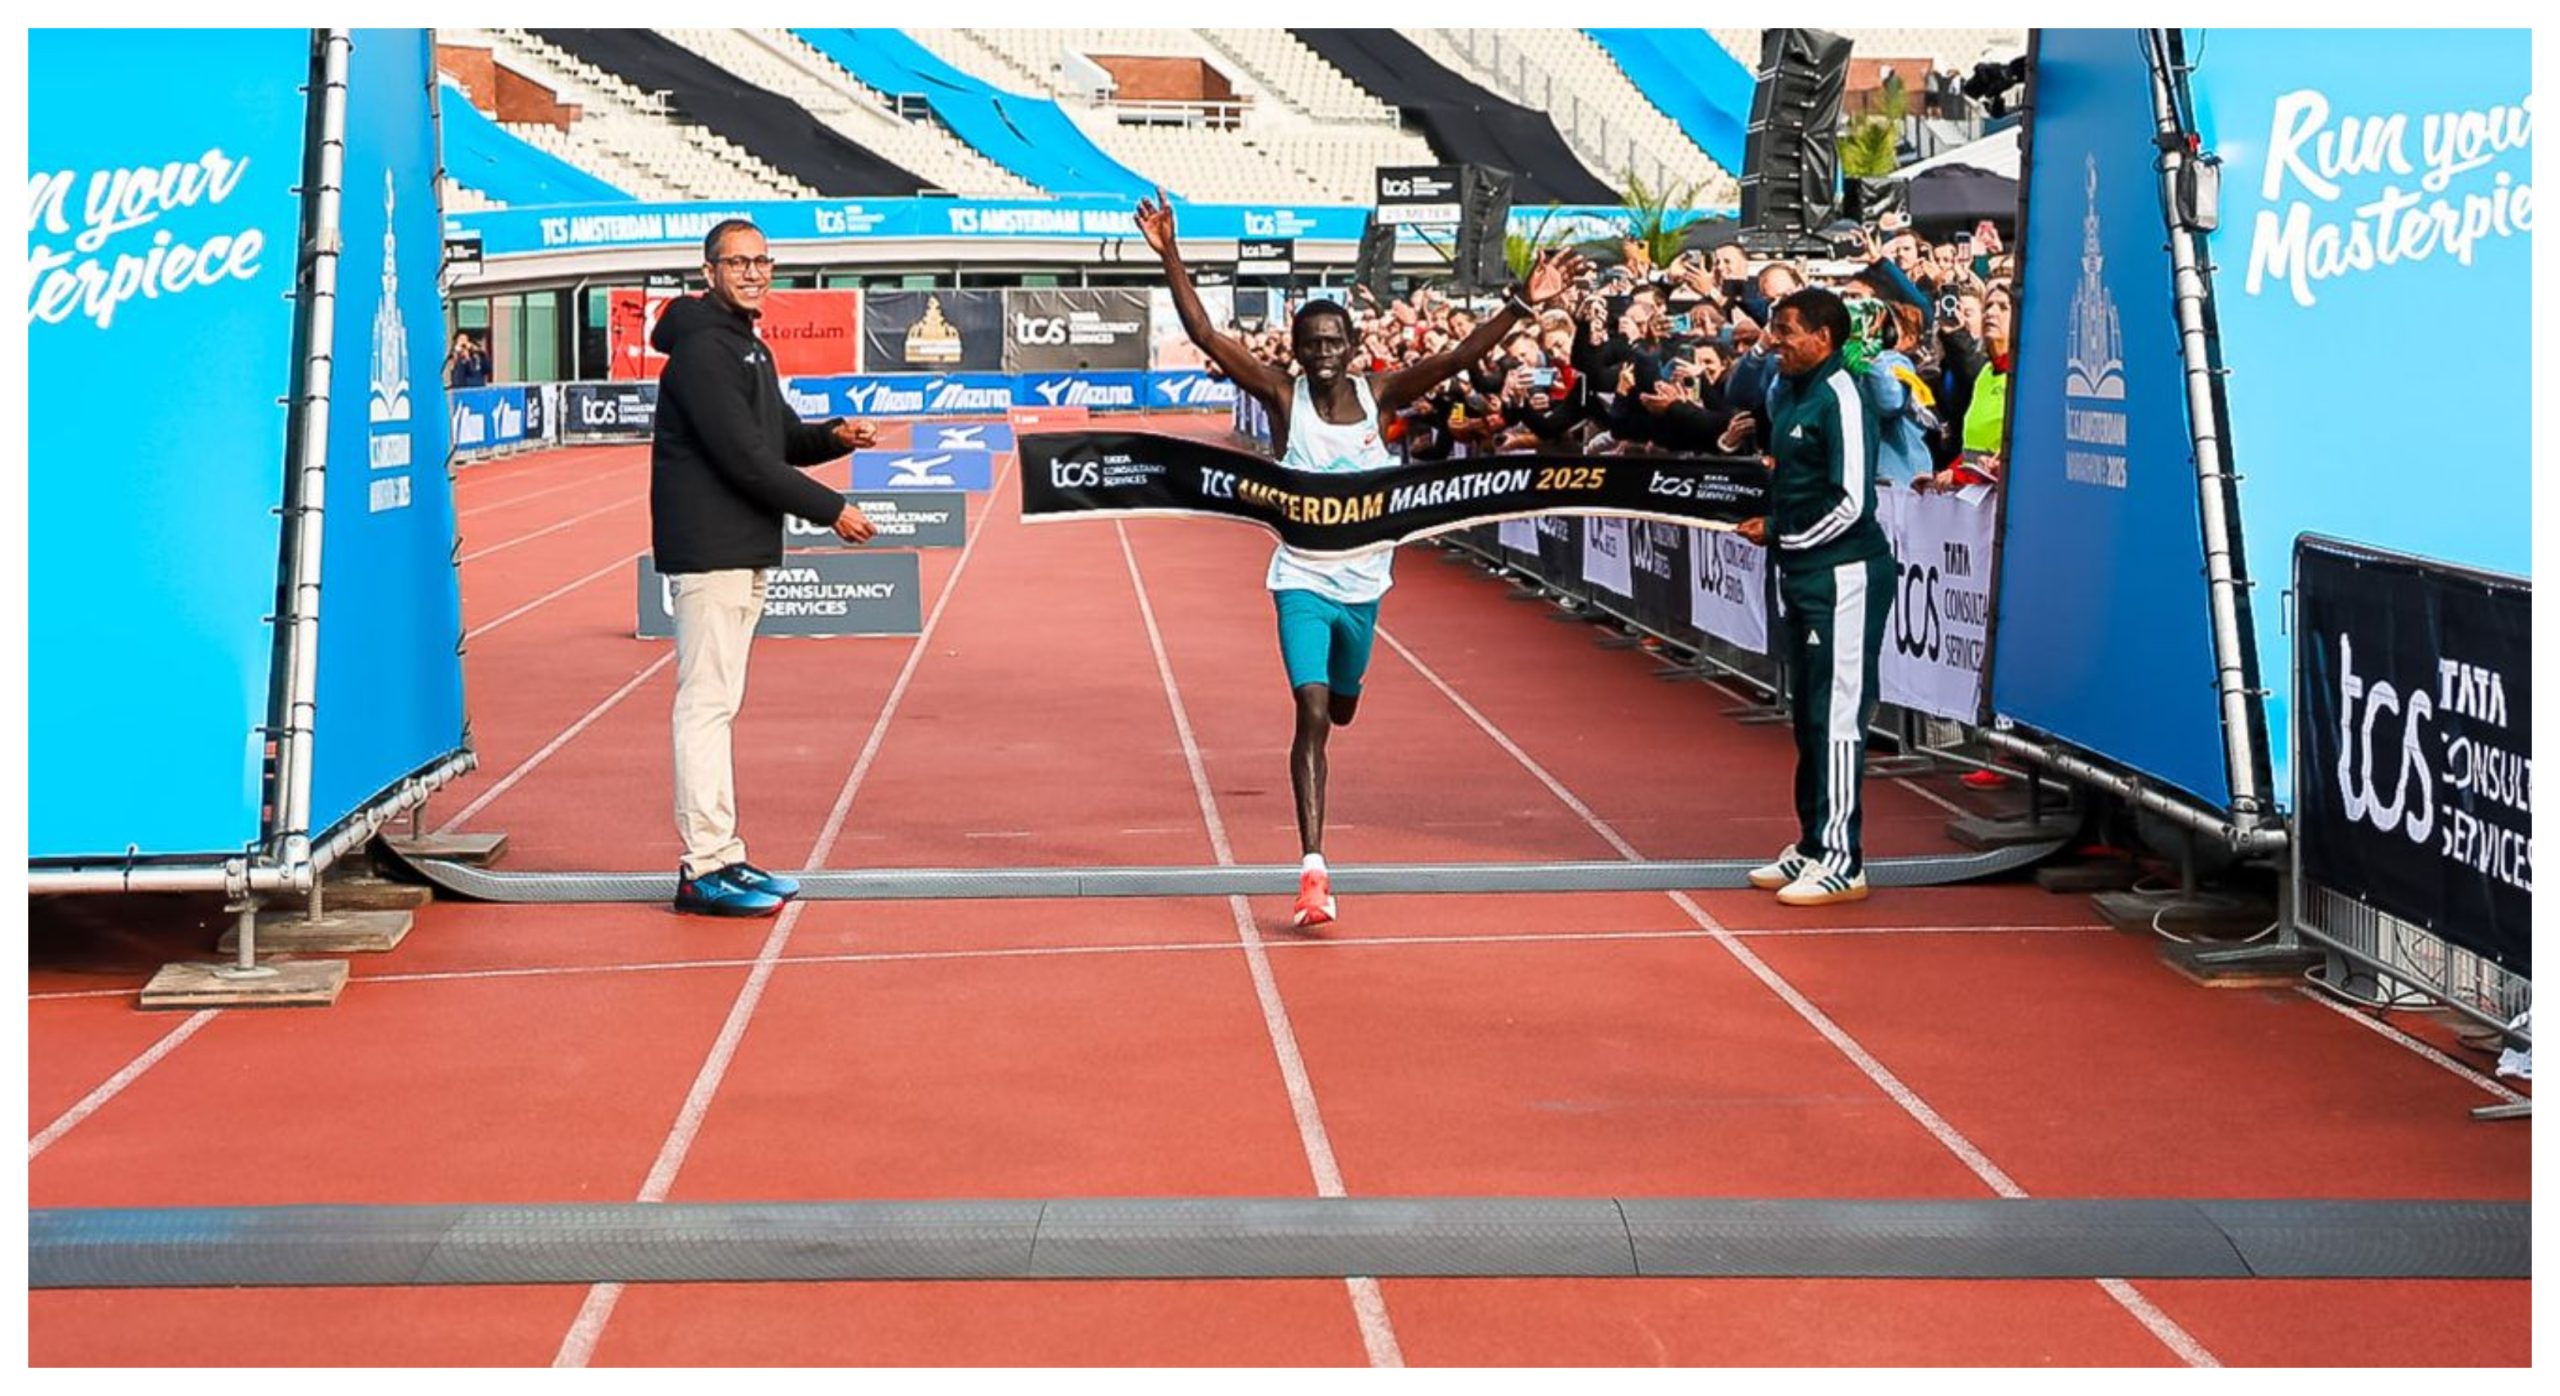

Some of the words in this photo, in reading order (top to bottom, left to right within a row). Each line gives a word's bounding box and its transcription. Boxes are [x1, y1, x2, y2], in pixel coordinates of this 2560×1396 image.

[2261, 89, 2413, 201] Run
[75, 147, 249, 254] your
[541, 217, 568, 246] TCS
[570, 213, 664, 243] AMSTERDAM
[815, 206, 846, 234] tcs
[949, 208, 977, 233] TCS
[2244, 171, 2532, 307] Masterpie
[28, 228, 264, 329] terpiece
[761, 321, 844, 339] sterdam
[1017, 312, 1066, 345] tcs
[582, 395, 617, 425] tcs
[1051, 458, 1098, 487] tcs
[1648, 470, 1695, 497] tcs
[858, 502, 898, 513] TATA
[1201, 467, 1236, 498] TCS
[1238, 478, 1384, 525] AMSTERDAM
[1389, 469, 1531, 514] MARATHON
[1536, 467, 1606, 491] 2025
[864, 511, 949, 524] ONSULTANCY
[764, 568, 820, 583] TATA
[1943, 541, 1971, 578] TATA
[764, 583, 895, 600] CONSULTANCY
[764, 600, 848, 616] SERVICES
[1893, 537, 1941, 663] tcs
[1944, 634, 1985, 673] SERVICE
[2439, 658, 2507, 728] TATA
[2338, 632, 2433, 844] tcs
